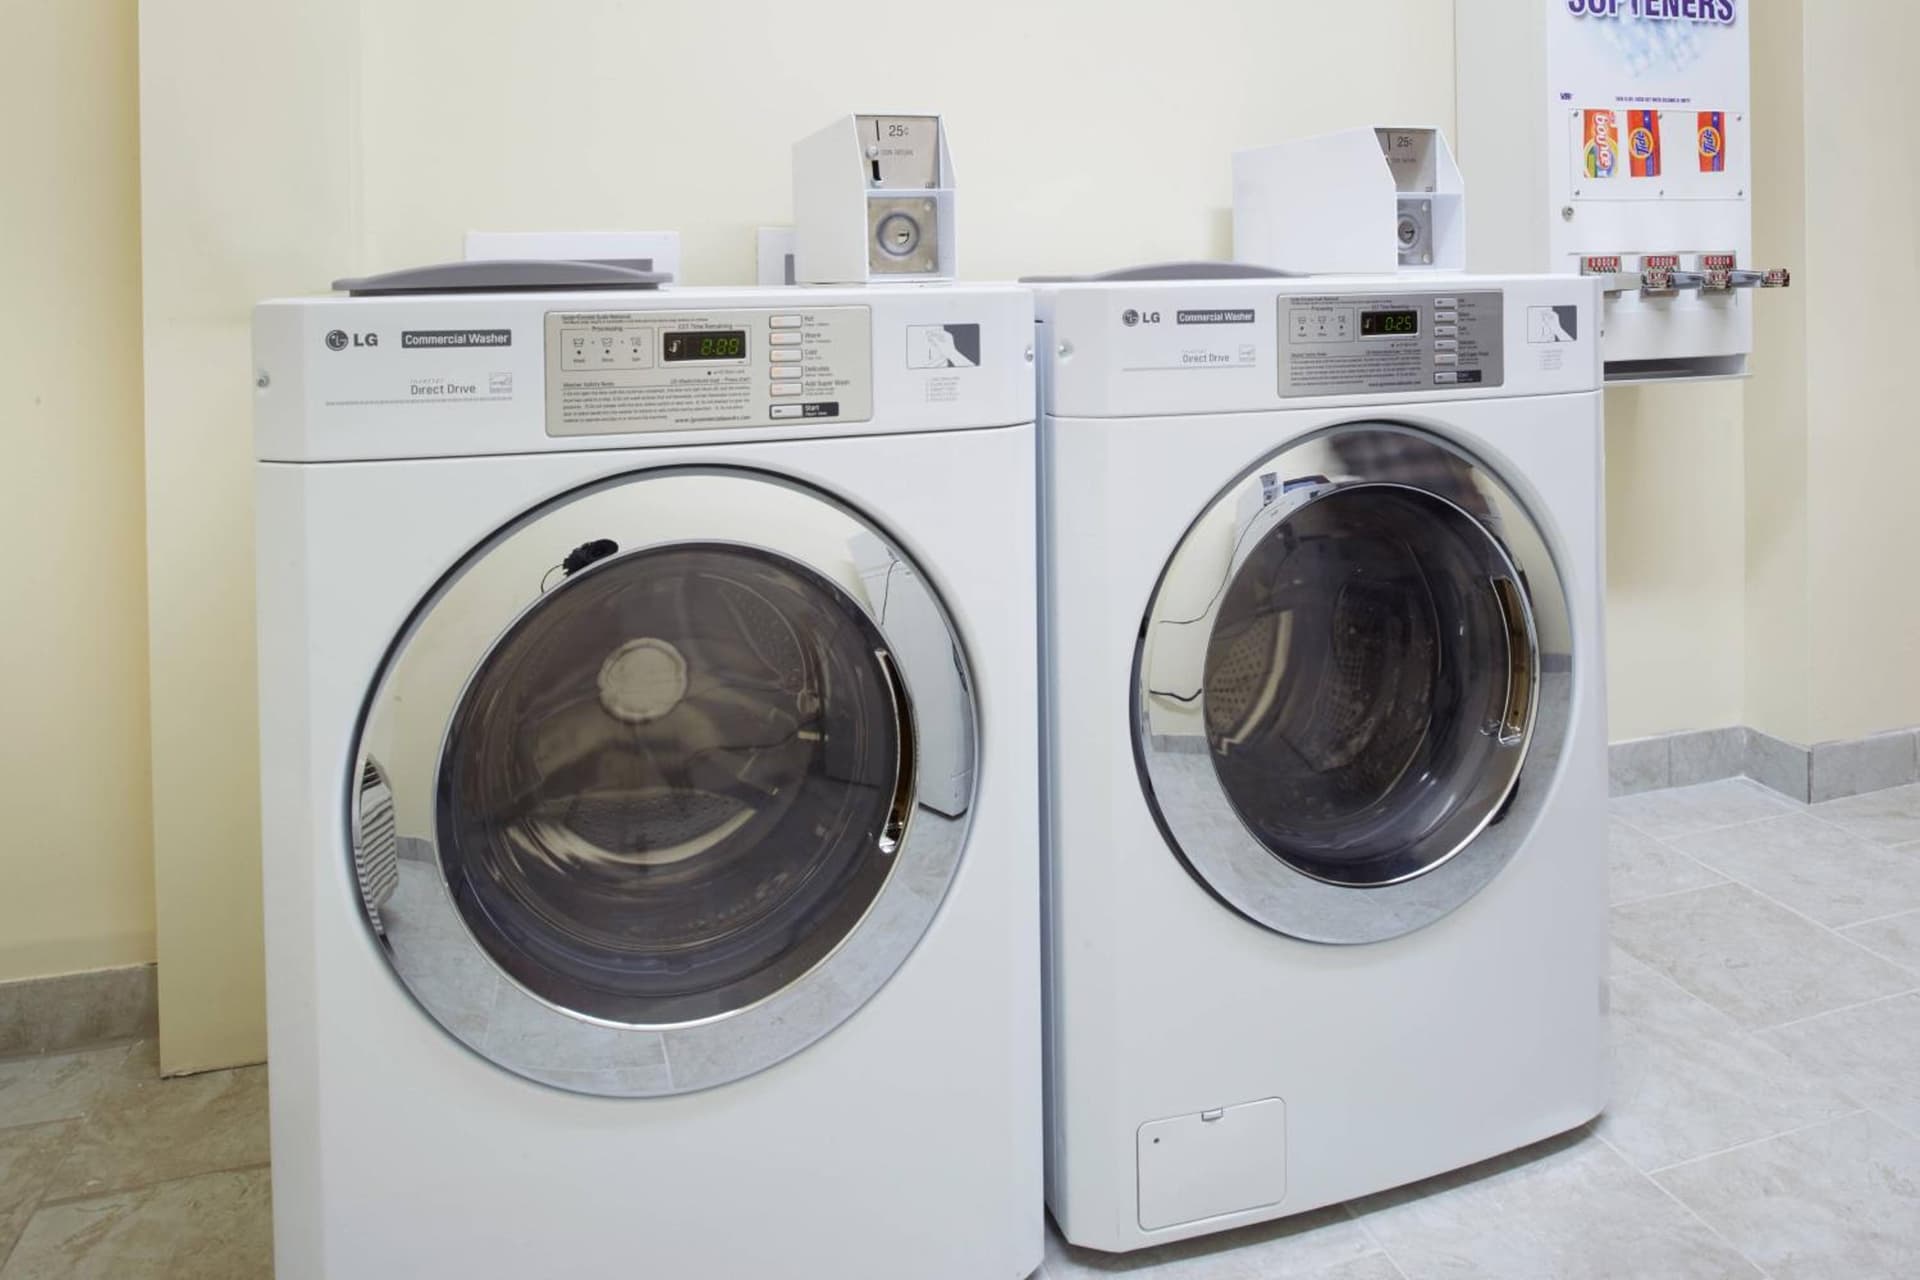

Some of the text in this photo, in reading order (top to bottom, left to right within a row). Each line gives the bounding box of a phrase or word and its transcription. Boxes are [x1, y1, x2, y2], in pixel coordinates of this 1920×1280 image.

[1634, 130, 1649, 155] Tide
[1703, 128, 1716, 154] Tide
[1142, 311, 1161, 324] LG
[1179, 311, 1253, 323] Commercial Washer
[353, 332, 379, 348] LG
[405, 332, 509, 346] Commercial Washer
[411, 384, 445, 396] Direct
[447, 383, 476, 395] Drive
